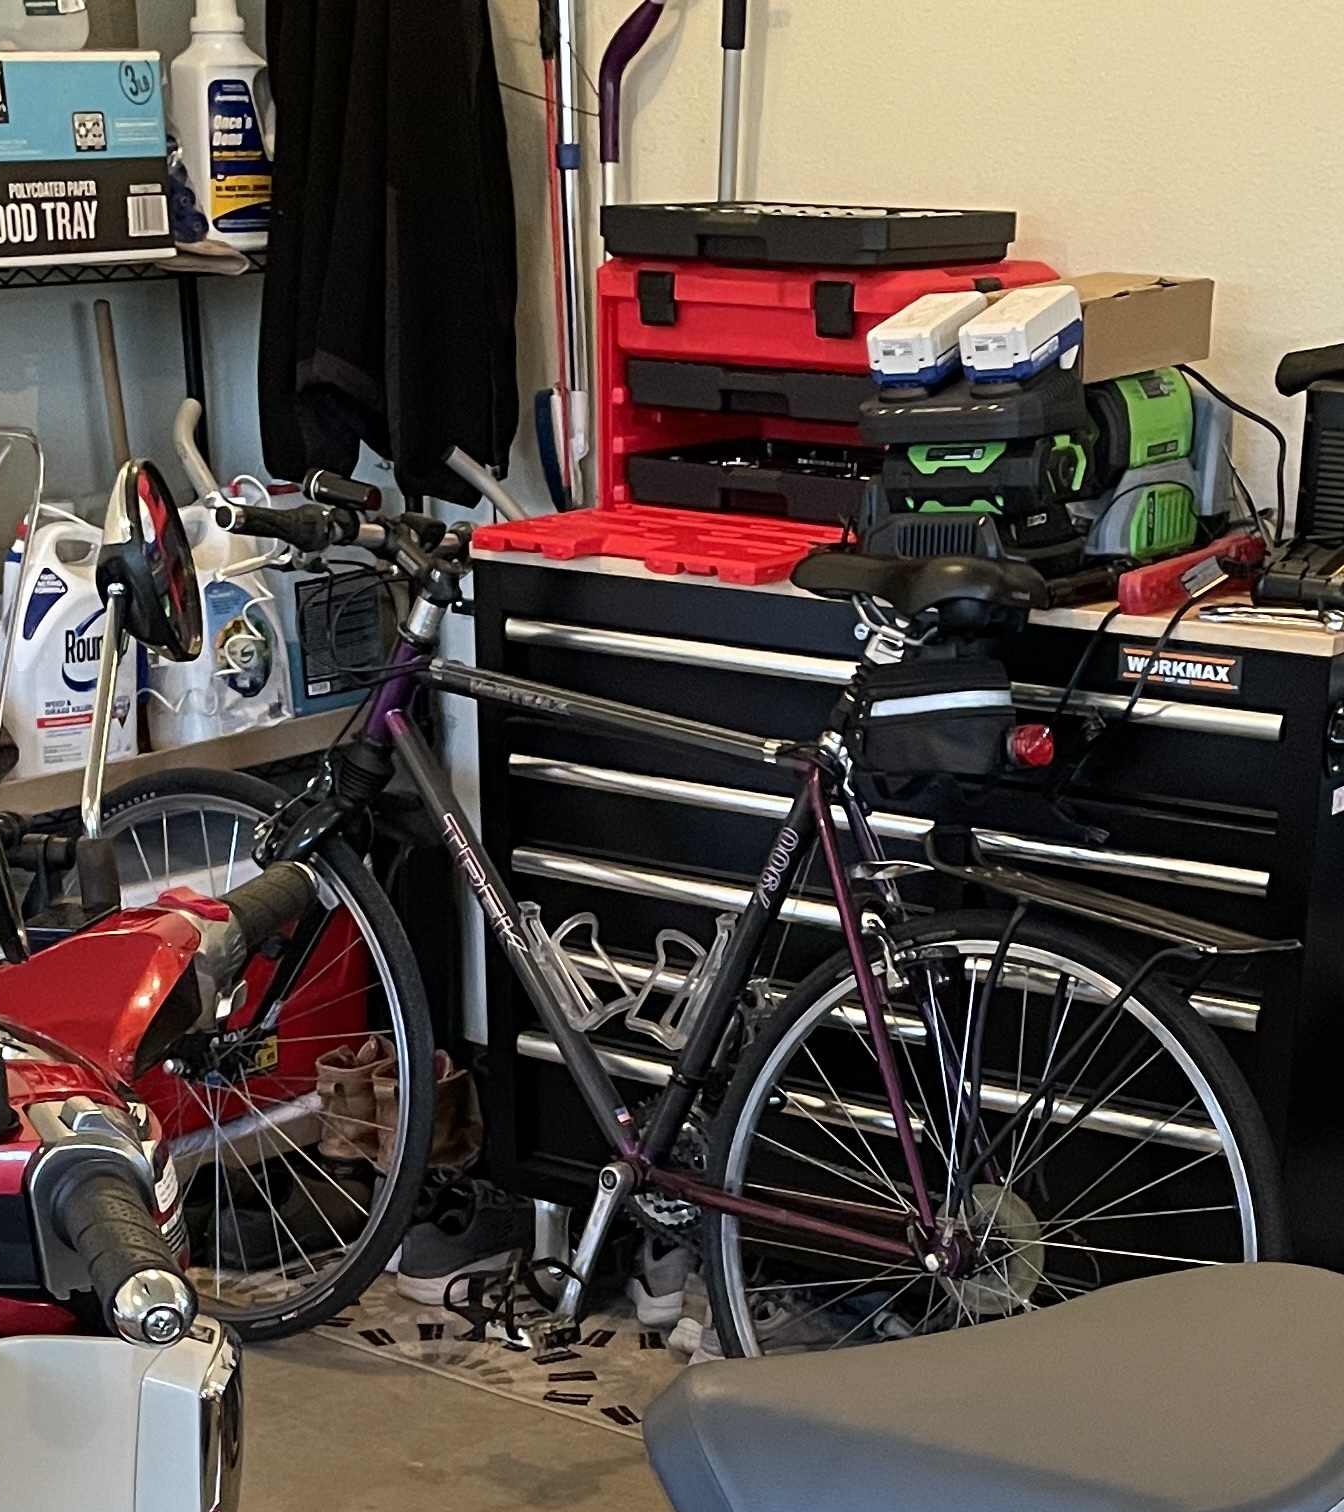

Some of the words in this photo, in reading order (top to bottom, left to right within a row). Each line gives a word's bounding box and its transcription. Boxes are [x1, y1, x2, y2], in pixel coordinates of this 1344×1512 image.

[8, 181, 66, 199] POLYCOATED
[67, 180, 97, 197] PAPER
[41, 199, 98, 241] TRAY
